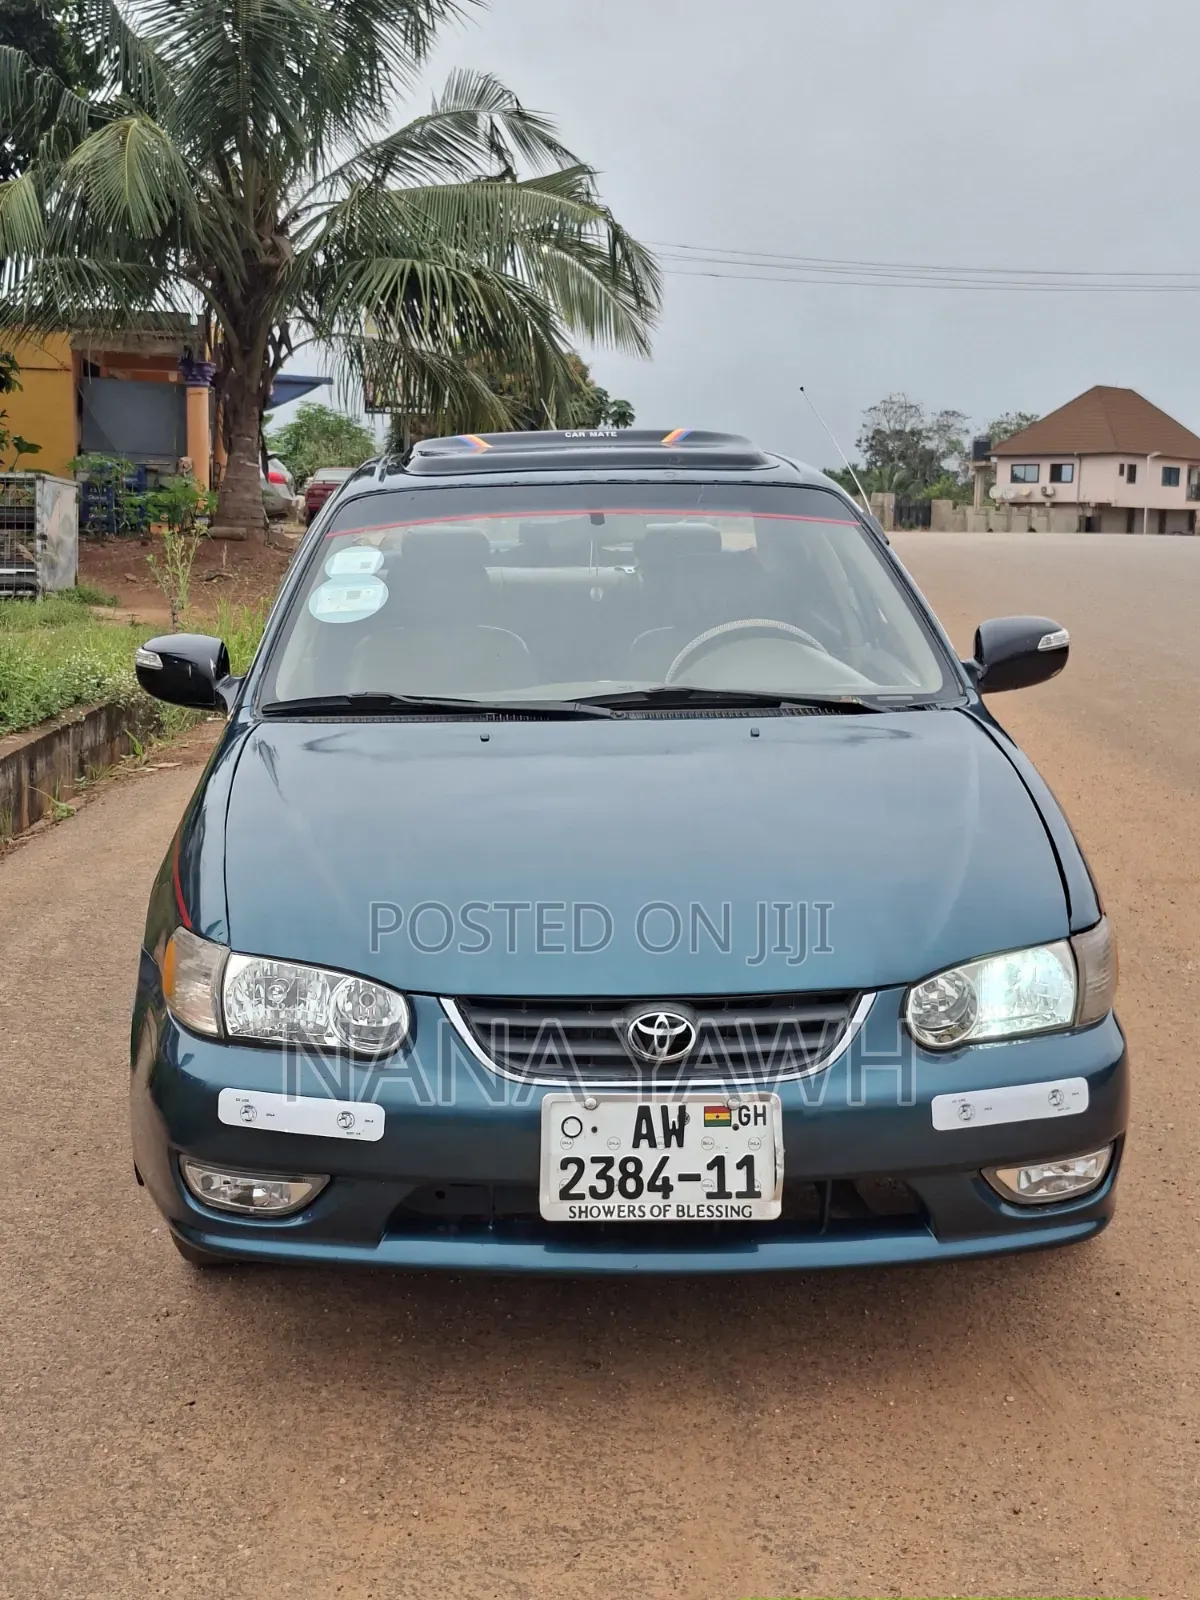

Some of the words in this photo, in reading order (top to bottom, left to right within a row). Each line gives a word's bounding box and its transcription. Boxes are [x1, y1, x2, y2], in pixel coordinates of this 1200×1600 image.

[632, 1105, 687, 1149] AW
[737, 1104, 767, 1126] GH
[559, 1154, 762, 1200] 2384-11
[568, 1204, 647, 1219] SHOWERS
[650, 1204, 672, 1218] OF
[675, 1204, 753, 1219] BLESSING
